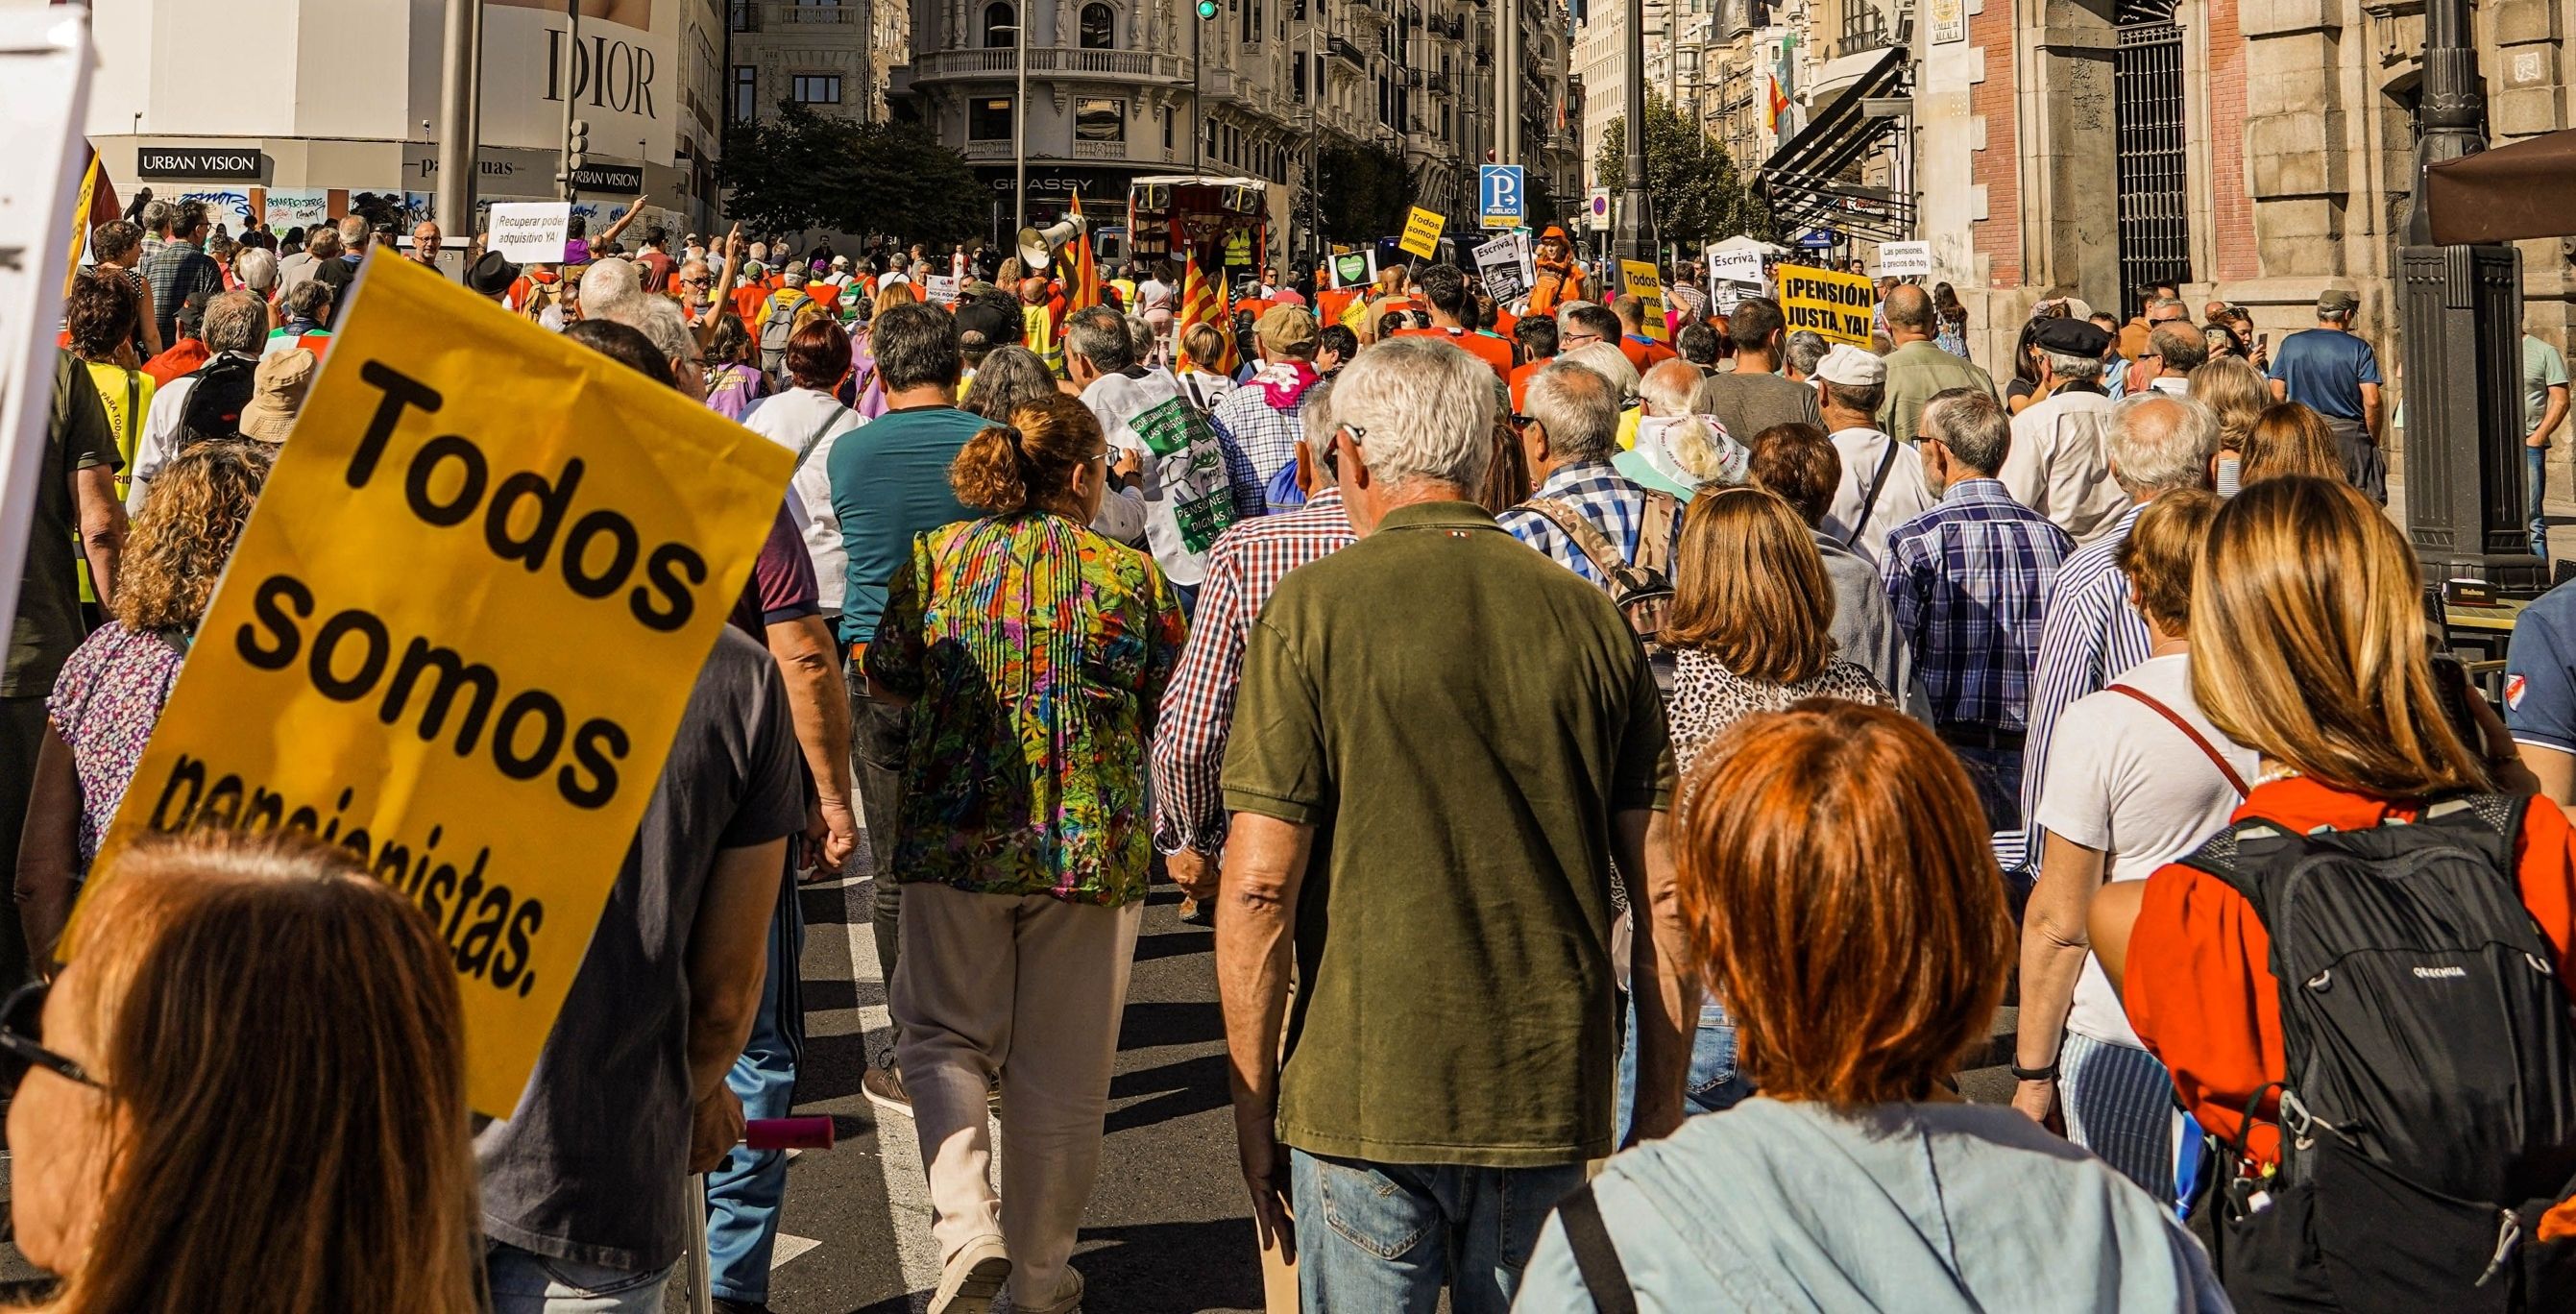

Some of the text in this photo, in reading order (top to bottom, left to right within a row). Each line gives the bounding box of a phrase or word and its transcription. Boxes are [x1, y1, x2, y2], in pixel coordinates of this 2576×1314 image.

[1933, 21, 1950, 31] CALLE
[543, 29, 656, 119] DIOR
[143, 156, 255, 170] URBAN VISION
[575, 170, 639, 186] RBAN VISION
[1489, 175, 1515, 207] P
[496, 215, 566, 229] ¡Recuperar poder
[1413, 213, 1440, 230] Todos
[498, 231, 558, 246] adquisitivo YA!
[1407, 226, 1436, 241] somos
[1887, 259, 1908, 269] precios
[1908, 258, 1915, 267] de
[1626, 271, 1657, 287] Todos
[1786, 278, 1870, 308] ¡PENSIÓN
[1642, 296, 1661, 308] mos
[1787, 305, 1870, 337] JUSTA, YA!
[100, 392, 118, 413] PARA
[1146, 427, 1160, 440] LAS
[1171, 431, 1182, 444] SE
[345, 359, 708, 632] Todos
[236, 573, 630, 809] somos
[2413, 966, 2467, 978] QUECHUA
